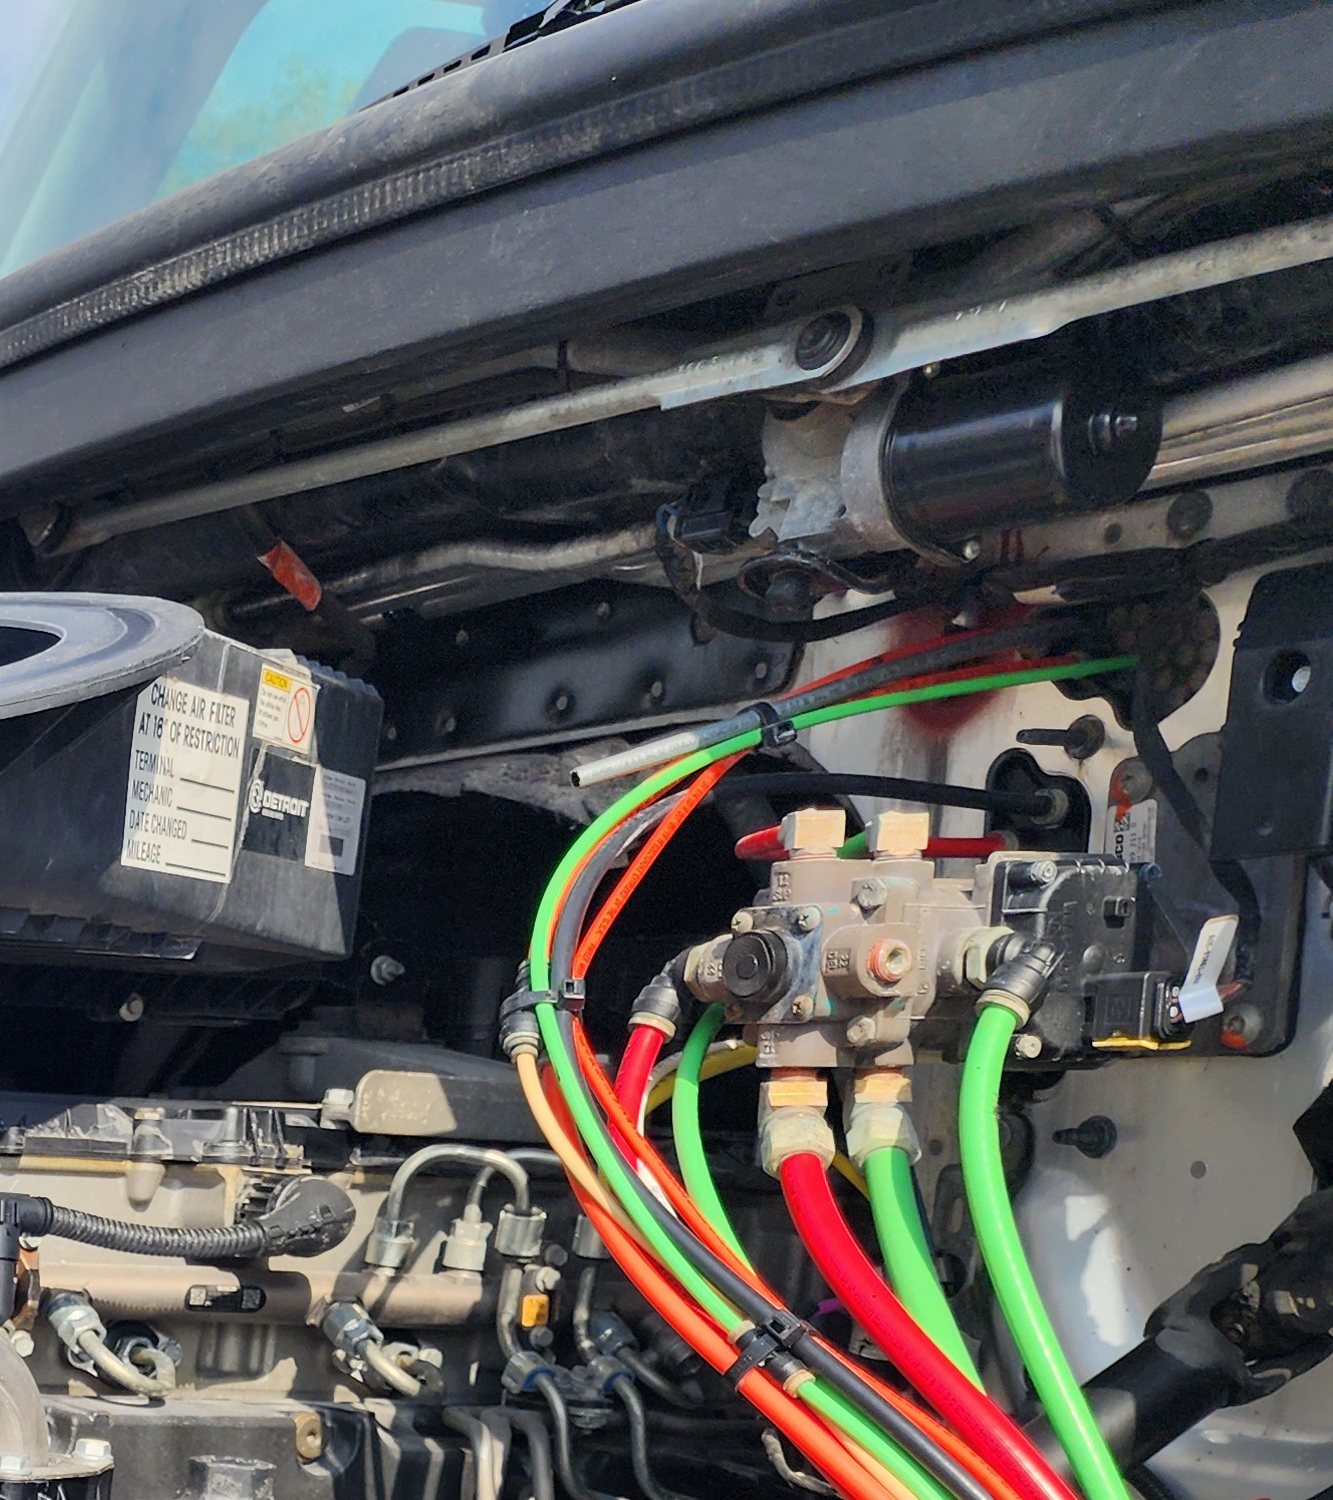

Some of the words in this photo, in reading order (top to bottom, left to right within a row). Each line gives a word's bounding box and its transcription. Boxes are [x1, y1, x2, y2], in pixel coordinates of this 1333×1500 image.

[150, 683, 188, 715] CHANGE
[190, 696, 206, 719] AIR
[209, 702, 236, 728] FILTER
[138, 712, 150, 735] AT
[170, 721, 181, 746] OF
[183, 724, 240, 759] RESTRICTION
[135, 749, 174, 778] TERMINAL
[132, 779, 173, 808] MECHANIC
[263, 789, 309, 817] DETROIT
[129, 809, 149, 833] DATE
[150, 815, 187, 840] CHANGED
[126, 839, 161, 864] MILEAGE
